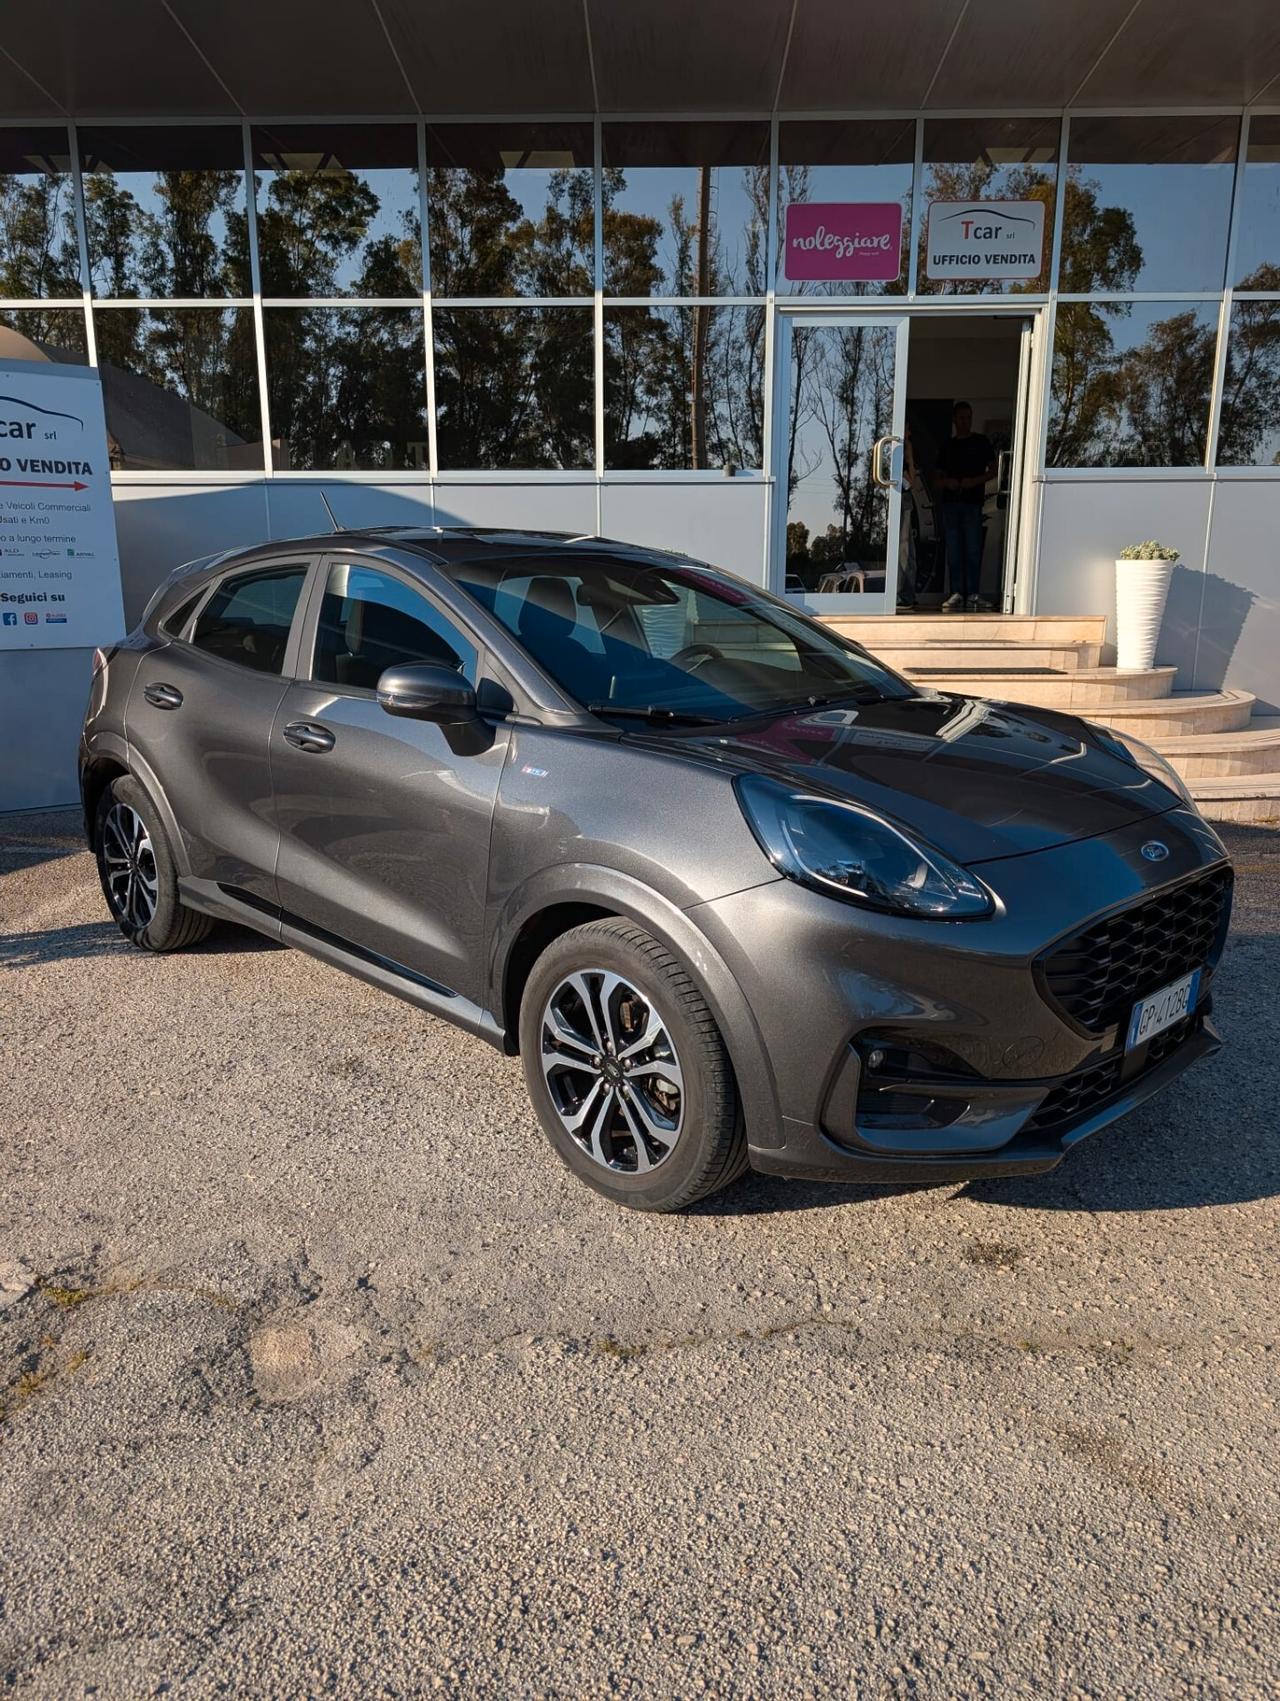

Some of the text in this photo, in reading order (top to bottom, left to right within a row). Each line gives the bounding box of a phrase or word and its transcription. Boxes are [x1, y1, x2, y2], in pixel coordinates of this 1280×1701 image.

[961, 220, 1015, 240] Tcar srl
[792, 225, 890, 258] noleggiare
[933, 253, 1036, 265] UFFICIO VENDITA
[44, 431, 57, 440] srl
[16, 458, 93, 475] VENDITA
[6, 501, 35, 511] Veicoli
[37, 502, 91, 512] Commerciali
[17, 534, 42, 544] lungo
[43, 535, 76, 543] termine
[38, 570, 73, 580] Leasing
[0, 592, 65, 604] Seguici su
